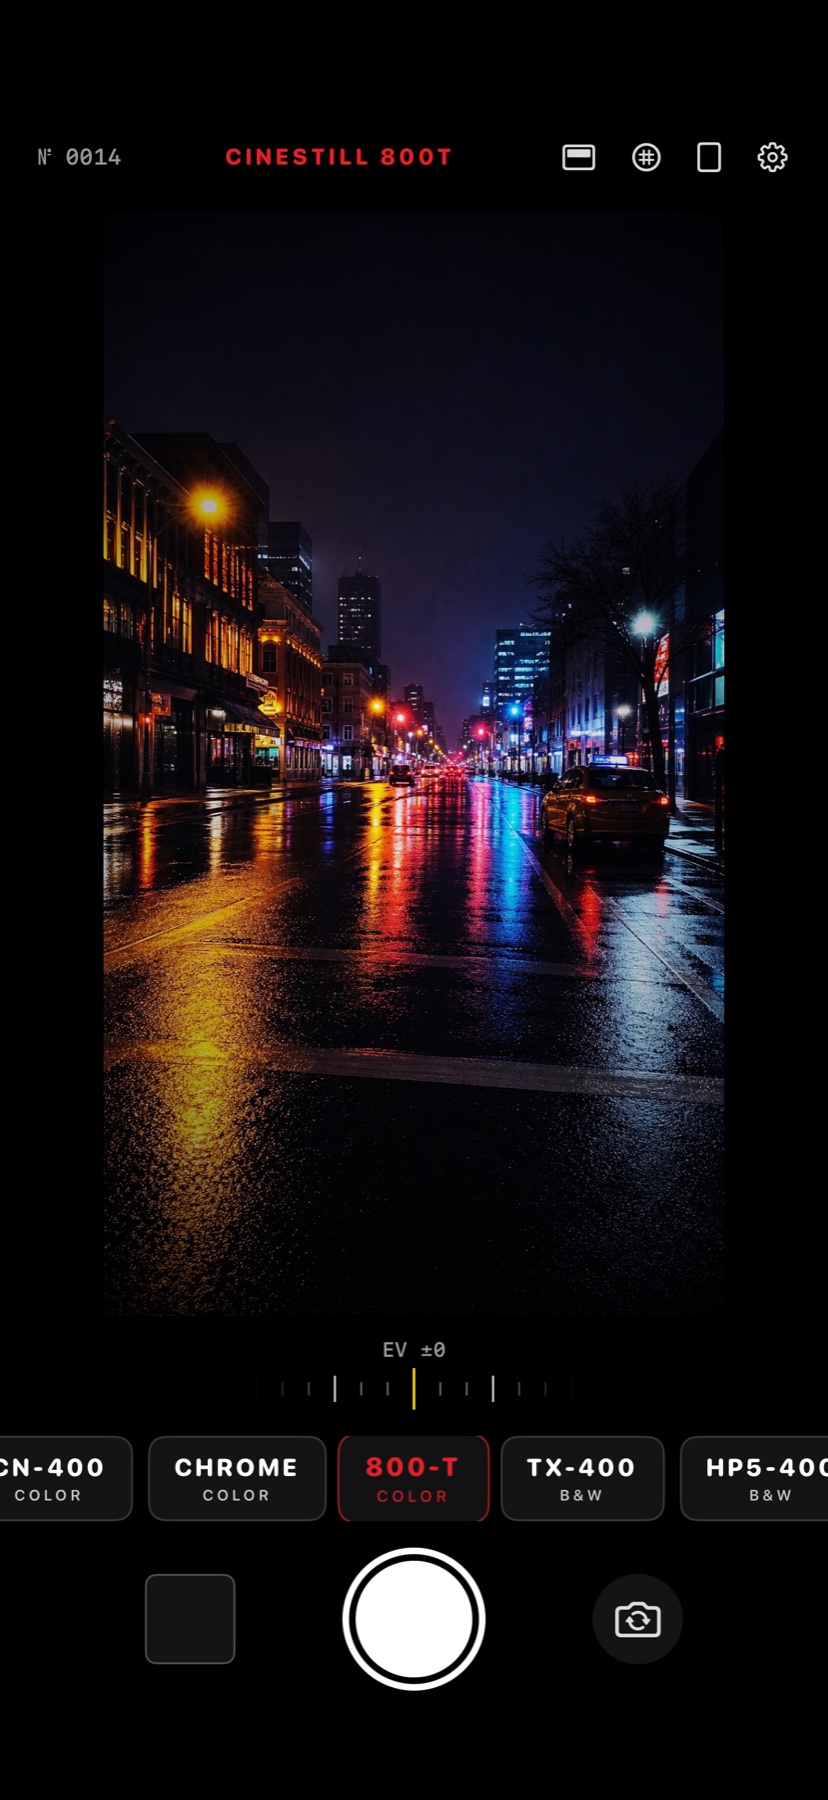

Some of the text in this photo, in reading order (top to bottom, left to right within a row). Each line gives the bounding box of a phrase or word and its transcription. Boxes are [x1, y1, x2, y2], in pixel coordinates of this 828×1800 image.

[67, 147, 122, 166] 0014
[225, 148, 452, 166] CINESTILL 800T
[383, 1341, 446, 1358] EV ±0
[174, 1458, 297, 1477] CHROME
[365, 1457, 459, 1477] 800-T
[526, 1458, 635, 1477] TX-400
[14, 1488, 81, 1502] COLOR
[202, 1488, 269, 1502] COLOR
[376, 1489, 448, 1503] COLOR
[559, 1489, 602, 1502] B&W
[749, 1489, 792, 1502] B&W
